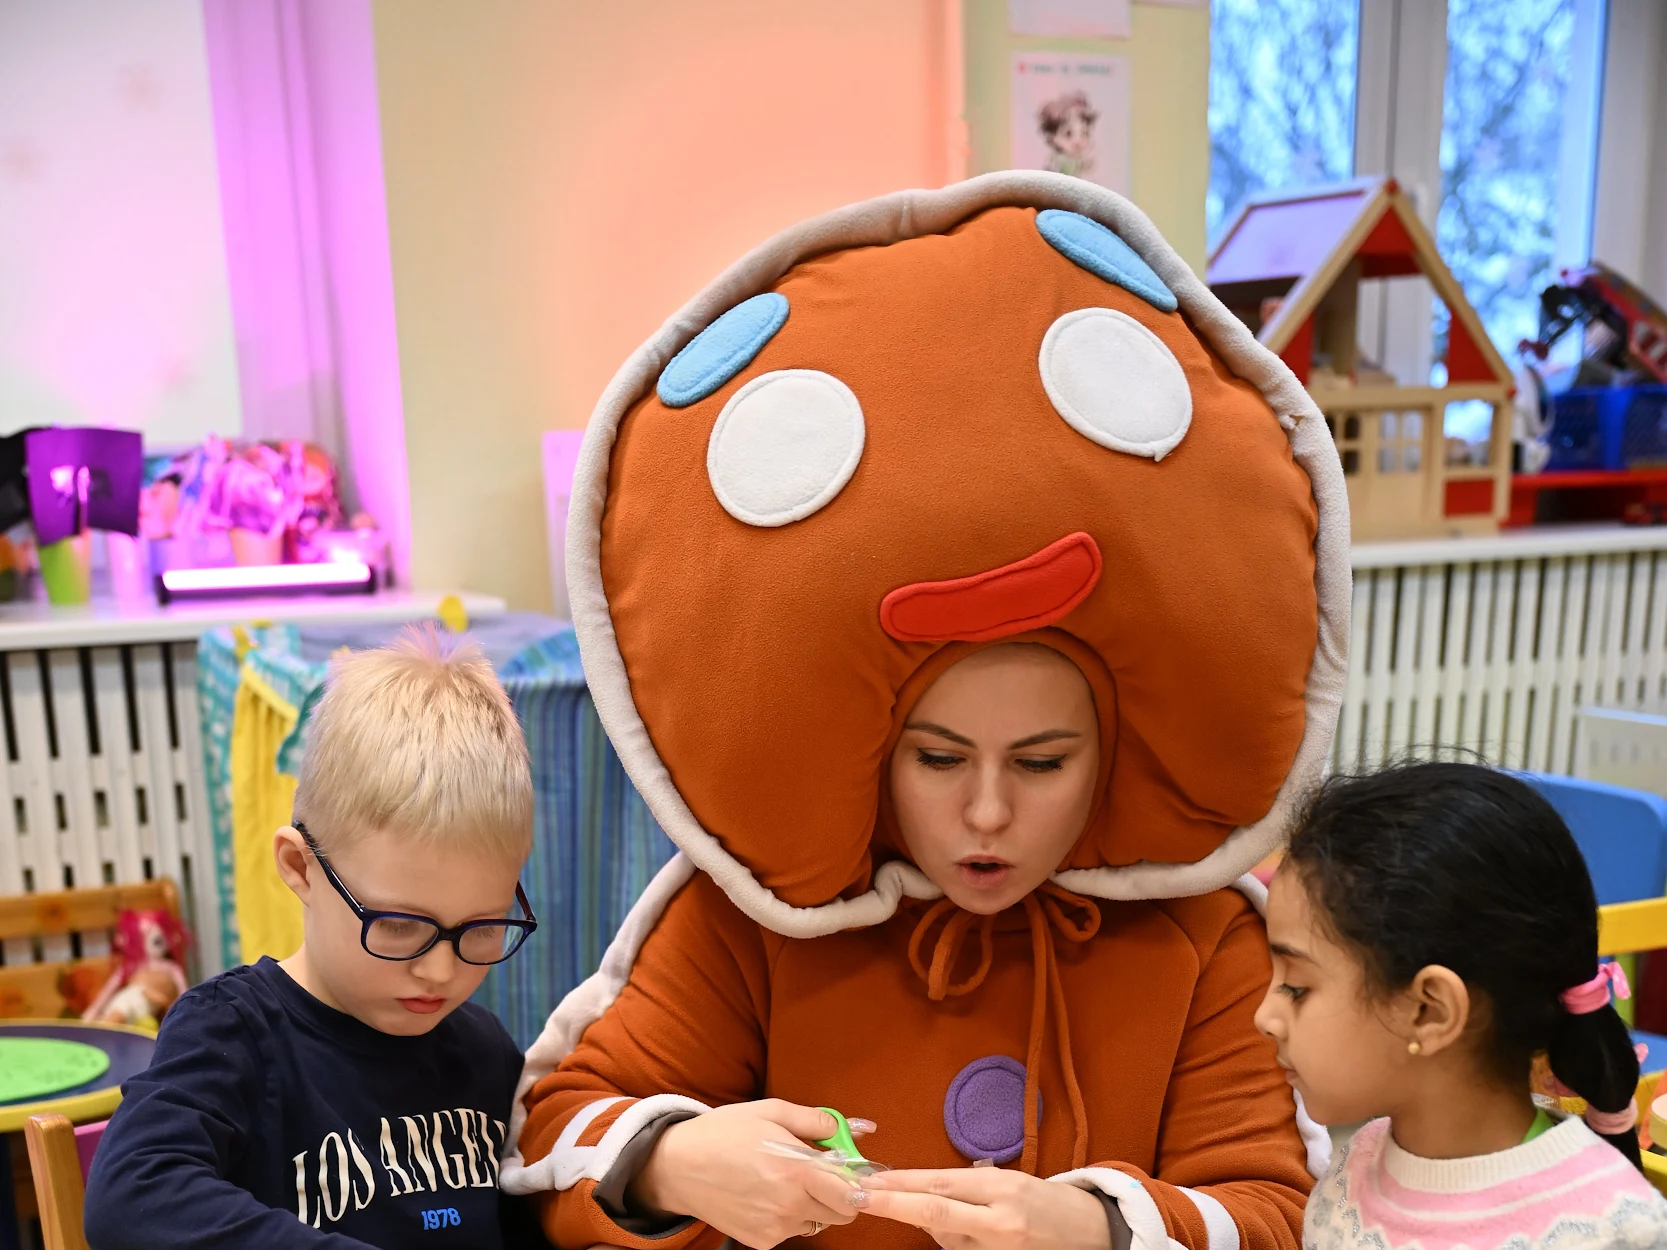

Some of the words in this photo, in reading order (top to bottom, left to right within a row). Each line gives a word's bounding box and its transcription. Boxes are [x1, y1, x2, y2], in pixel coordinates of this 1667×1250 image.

[292, 1127, 376, 1229] LOS
[379, 1108, 507, 1196] ANGEL
[421, 1207, 462, 1231] 1978
